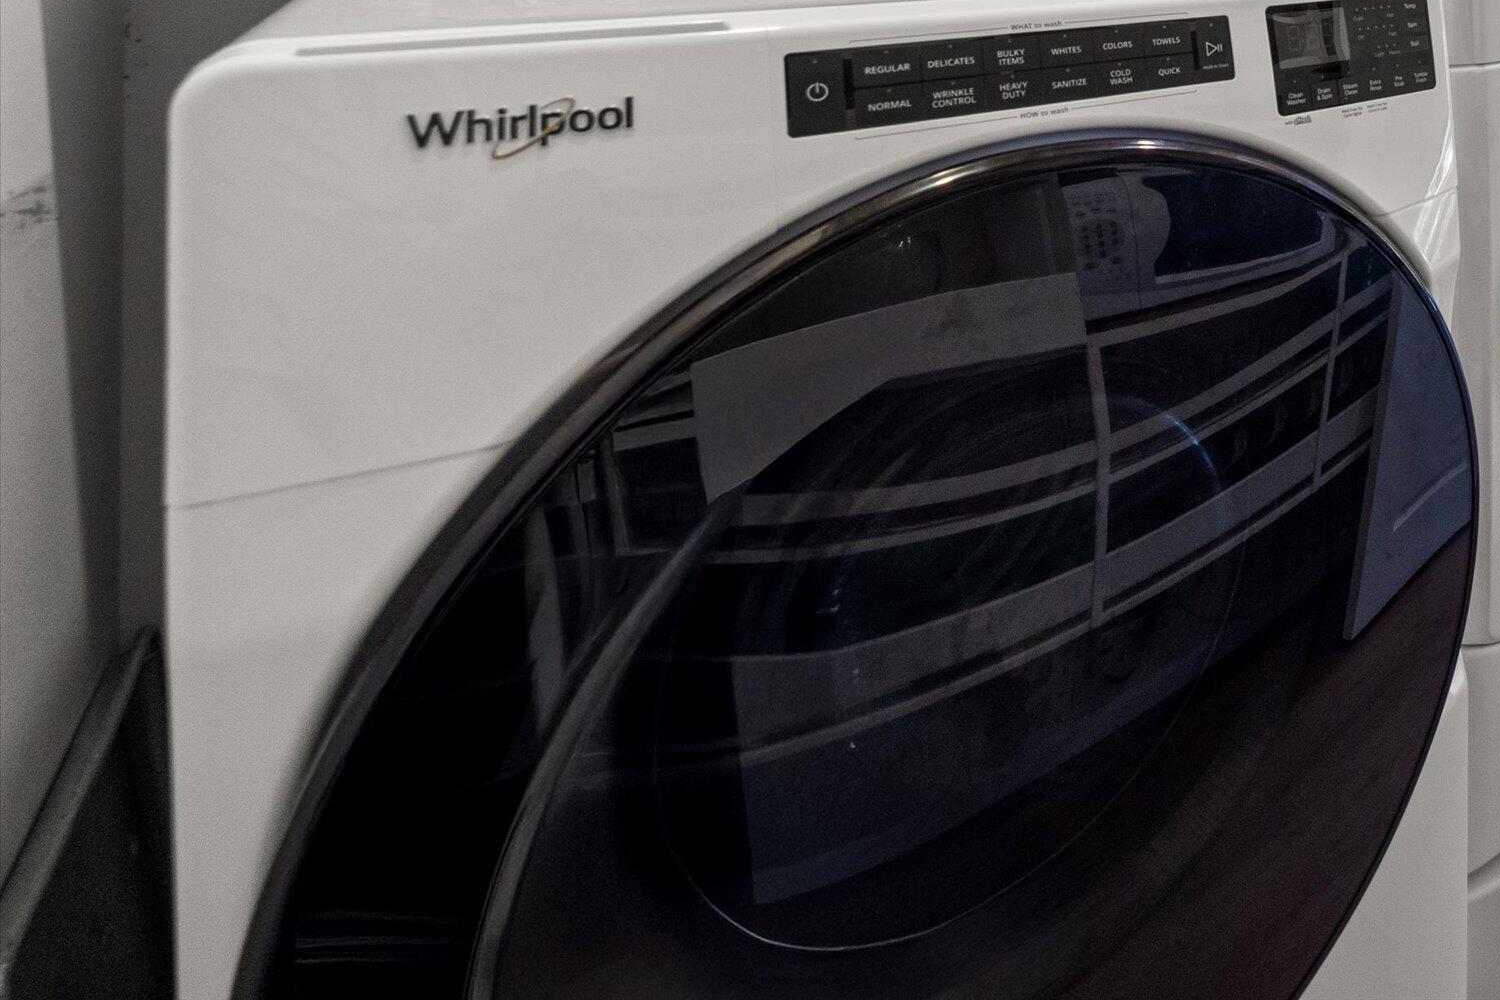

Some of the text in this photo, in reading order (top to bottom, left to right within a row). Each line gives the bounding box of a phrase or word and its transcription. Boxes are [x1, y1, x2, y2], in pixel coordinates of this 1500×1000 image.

[1010, 22, 1032, 31] WHAT
[1043, 20, 1063, 29] wash
[1102, 40, 1133, 51] COLORS
[1152, 36, 1181, 46] TOWELS
[996, 48, 1025, 58] BULKY
[1050, 45, 1082, 56] WHITES
[927, 56, 976, 69] DELICATES
[998, 56, 1025, 66] ITEMS
[864, 62, 911, 75] REGULAR
[1110, 68, 1131, 78] COLD
[1158, 66, 1181, 77] QUICK
[999, 81, 1028, 92] HEAVY
[1051, 77, 1088, 90] SANITIZE
[1109, 76, 1133, 86] WASH
[932, 87, 975, 100] WRINKLE
[1002, 90, 1026, 100] DUTY
[867, 99, 913, 112] NORMAL
[931, 95, 977, 109] CONTROL
[1286, 98, 1306, 106] Washer
[1020, 106, 1070, 120] HOW to wash
[405, 96, 635, 149] Whirlpool
